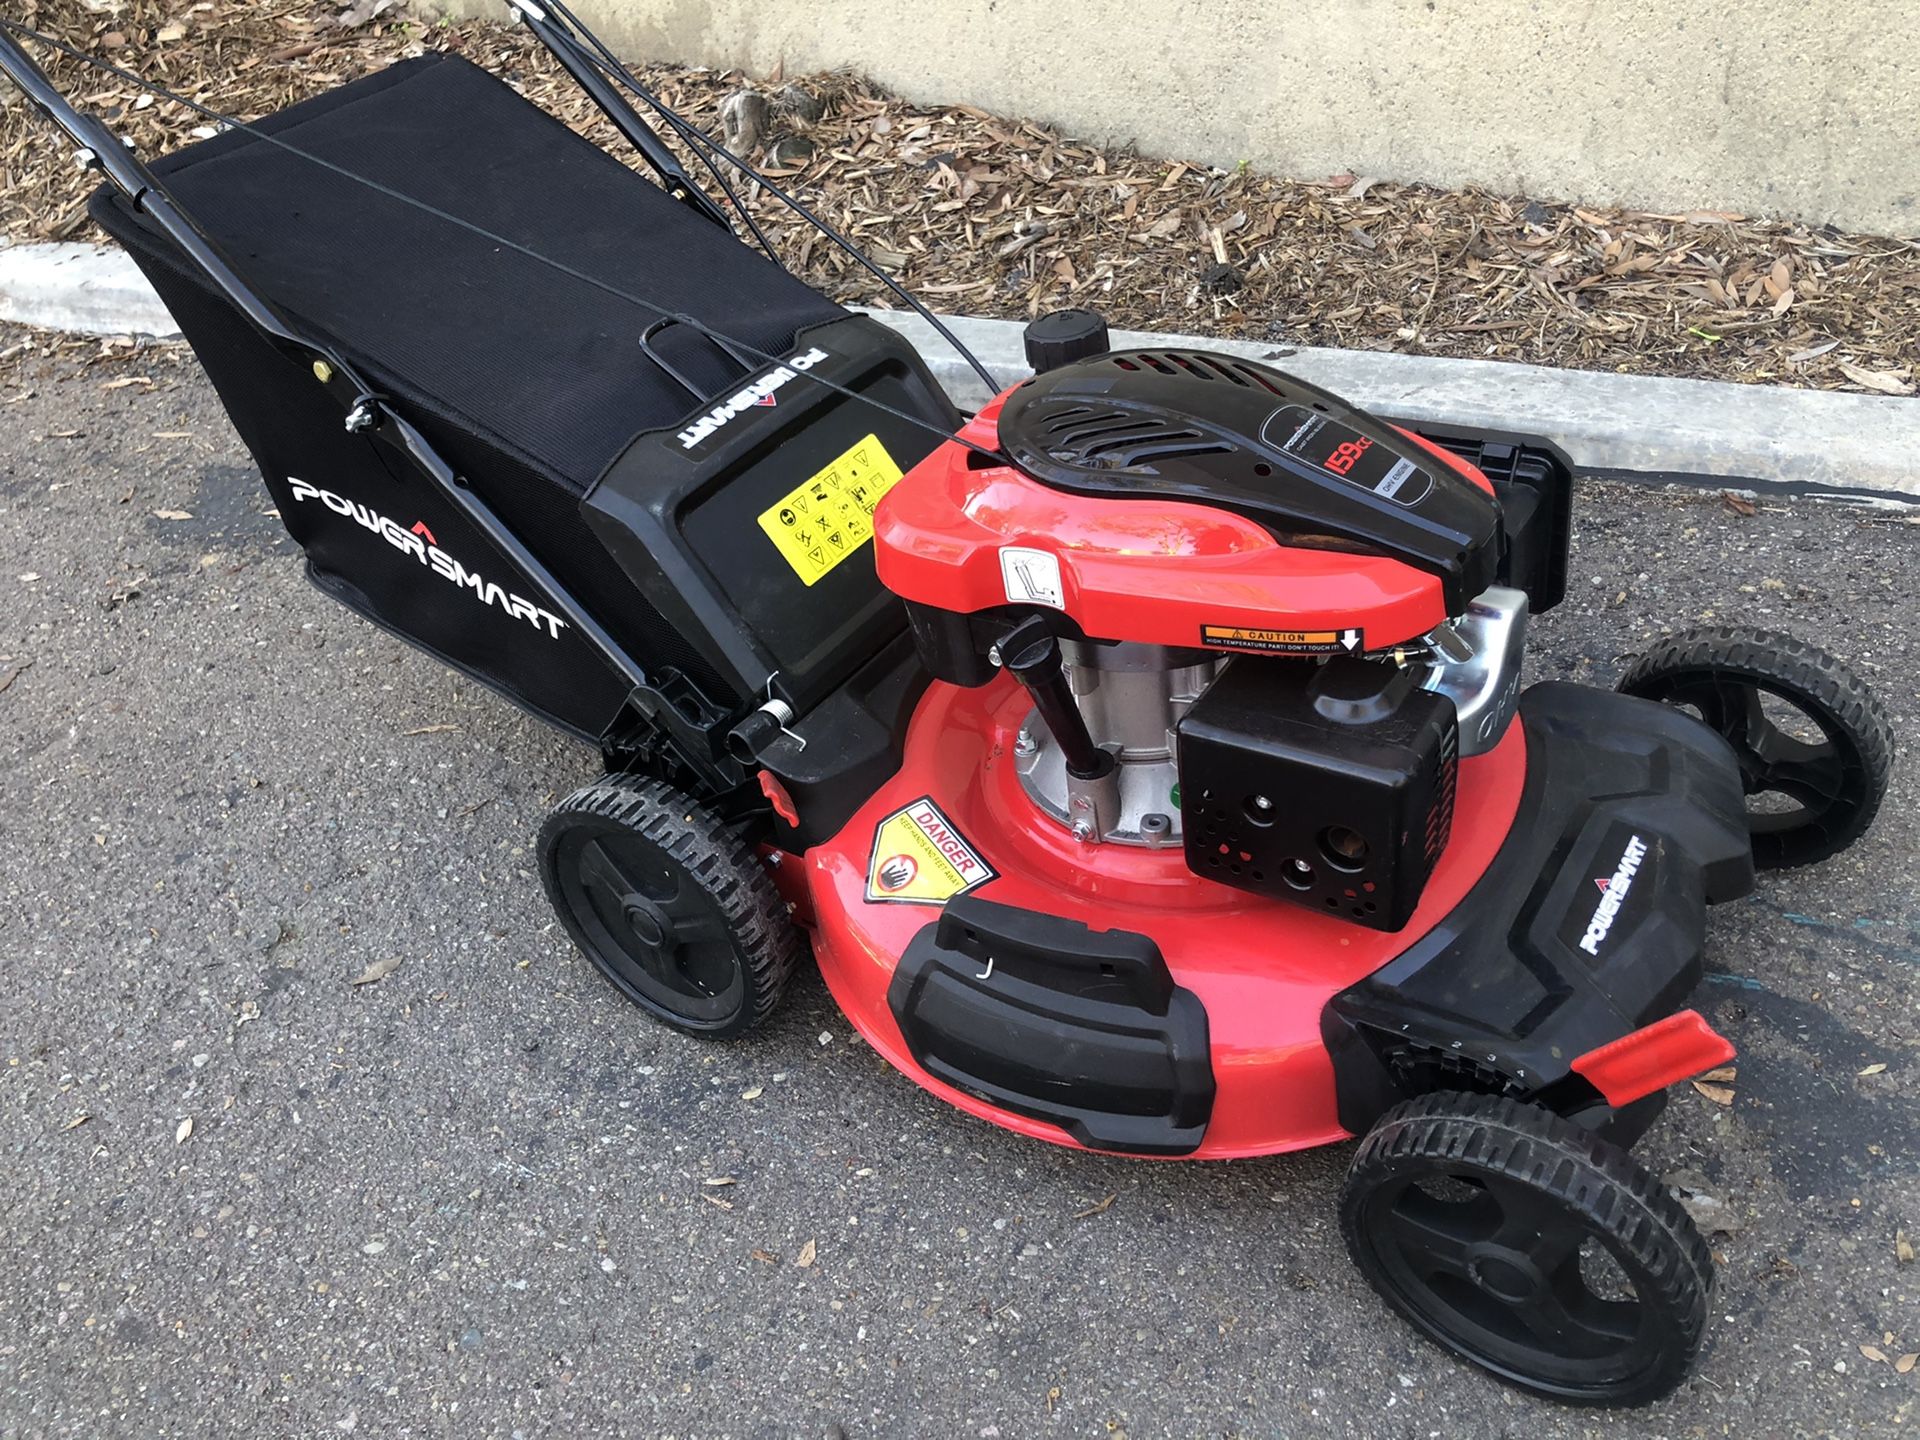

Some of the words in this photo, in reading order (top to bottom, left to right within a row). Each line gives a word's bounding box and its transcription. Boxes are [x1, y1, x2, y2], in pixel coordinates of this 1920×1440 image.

[1323, 436, 1374, 475] 159cc
[286, 476, 565, 640] POWERSMART
[1223, 639, 1266, 648] TEMPERATURE
[1248, 631, 1305, 641] CAUTION
[900, 817, 913, 830] KEEP
[911, 830, 927, 848] HANDS
[924, 846, 937, 858] AND
[934, 856, 948, 870] FEET
[944, 870, 960, 887] AWAY
[916, 811, 976, 874] DANGER
[1579, 835, 1648, 956] POWERSMART
[1451, 1040, 1462, 1048] 2
[1487, 1053, 1496, 1062] 3
[1516, 1069, 1524, 1077] 4
